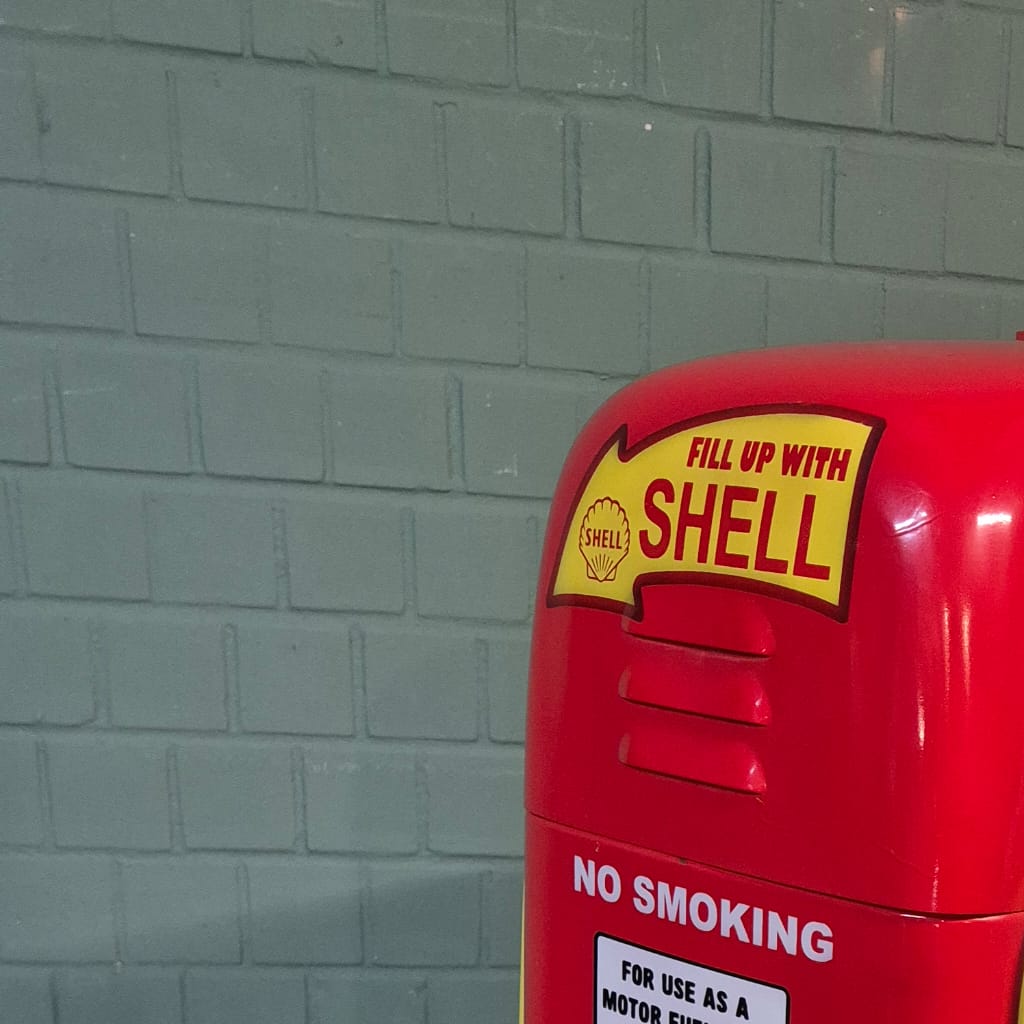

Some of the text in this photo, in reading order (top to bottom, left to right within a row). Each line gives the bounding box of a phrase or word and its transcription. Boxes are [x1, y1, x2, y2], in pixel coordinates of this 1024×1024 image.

[686, 436, 852, 482] FILL UP WITH
[585, 529, 622, 551] SHELL
[639, 478, 831, 581] SHELL
[574, 855, 834, 963] NO SMOKING
[621, 960, 750, 1020] FOR USE AS A
